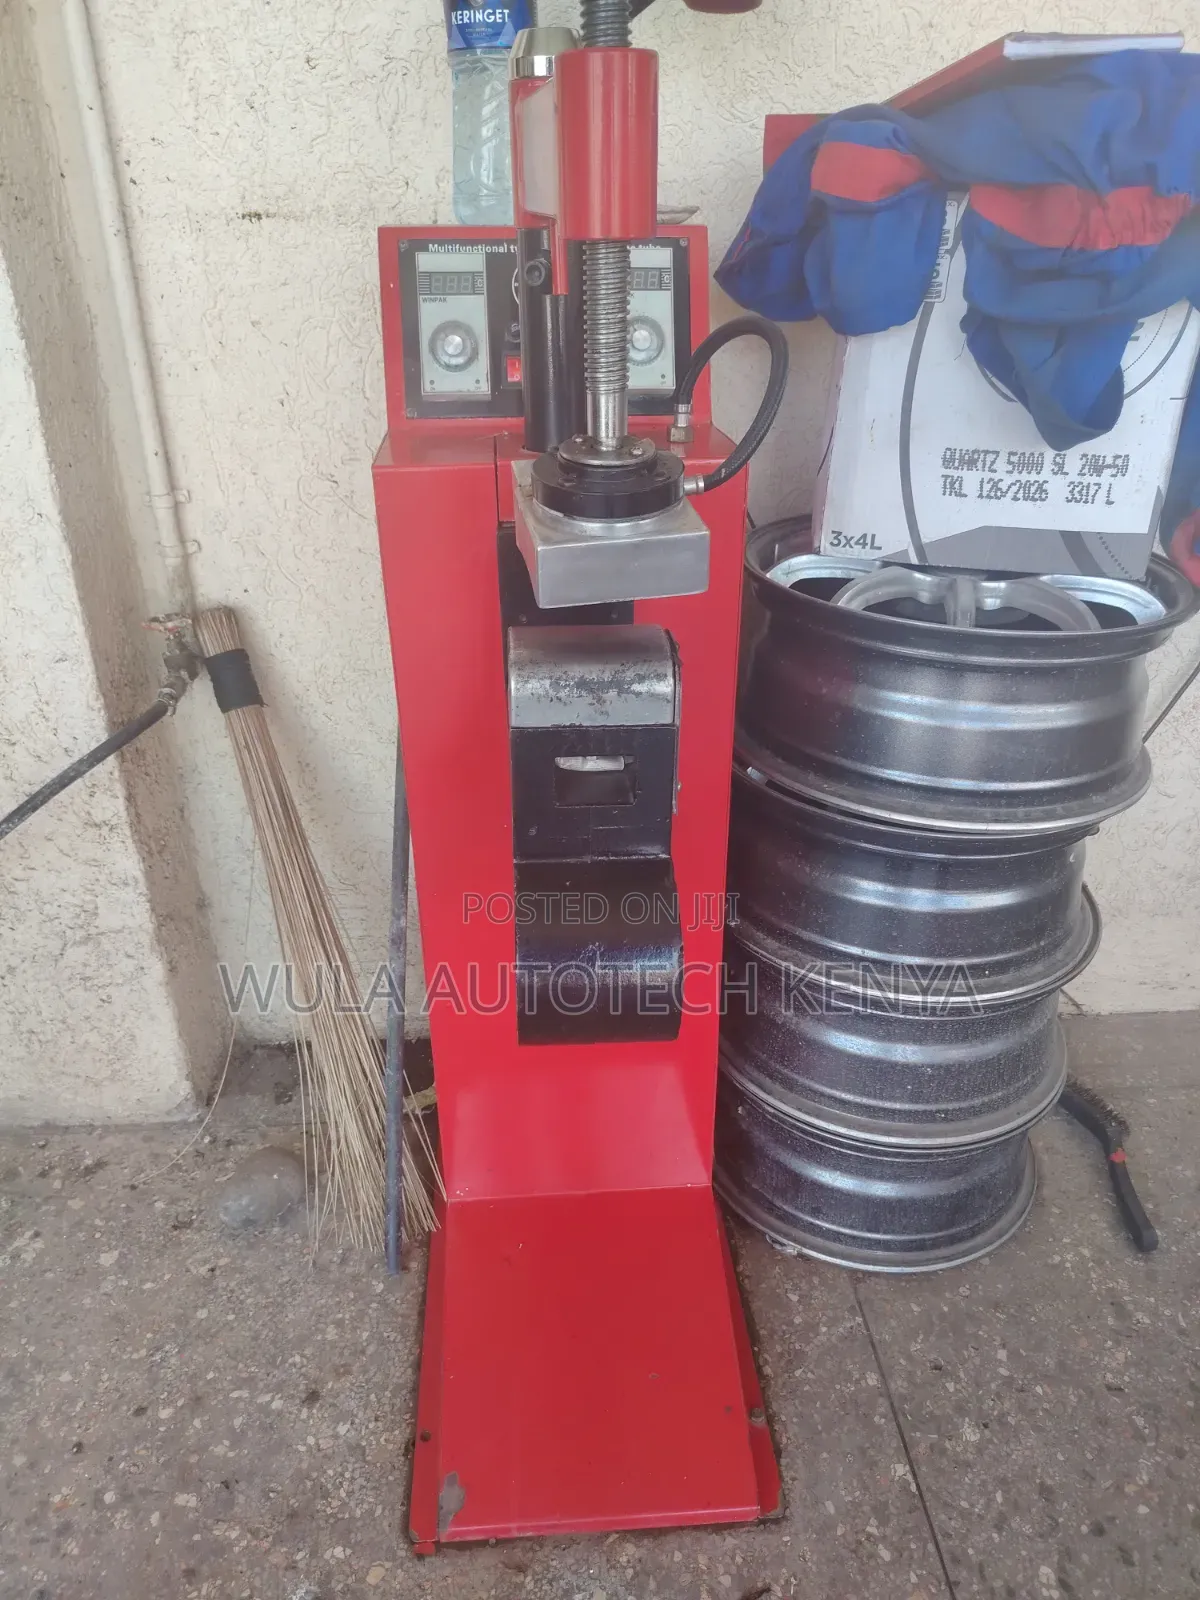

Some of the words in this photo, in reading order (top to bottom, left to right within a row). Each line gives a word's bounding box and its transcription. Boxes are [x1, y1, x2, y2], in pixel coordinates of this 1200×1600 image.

[451, 9, 510, 25] KERINGET
[428, 242, 508, 253] Multifunctional
[941, 447, 1000, 473] QUARTZ
[1005, 451, 1045, 475] 5000
[1051, 453, 1069, 476] SL
[941, 474, 968, 498] TKL
[977, 478, 1049, 502] 126/2026
[829, 530, 882, 550] 3x4L
